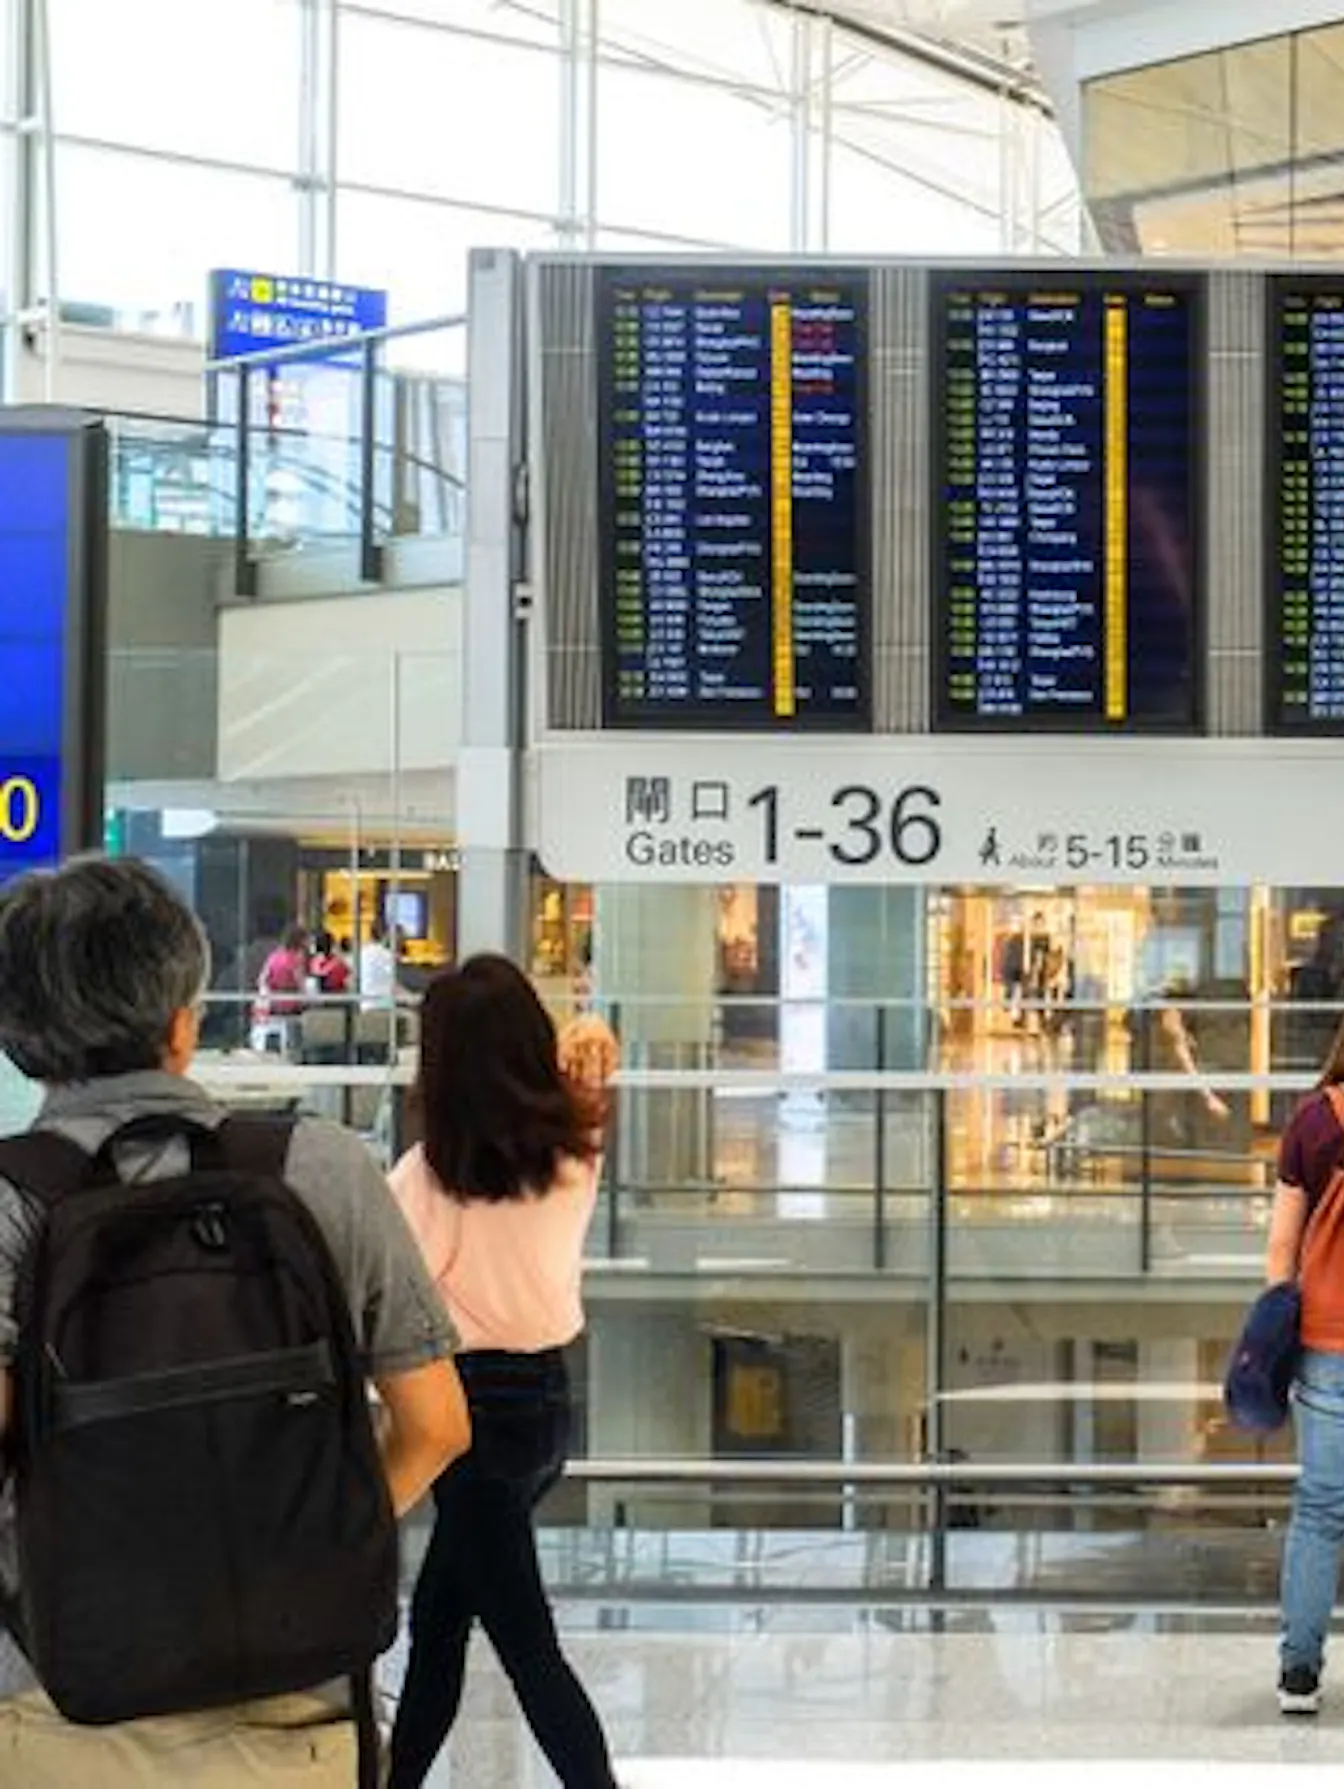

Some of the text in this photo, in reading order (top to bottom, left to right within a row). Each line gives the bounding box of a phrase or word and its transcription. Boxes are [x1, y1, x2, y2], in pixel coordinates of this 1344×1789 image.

[0, 775, 37, 843] 0
[626, 784, 942, 866] Gates 1-36
[1066, 834, 1149, 870] 5-15
